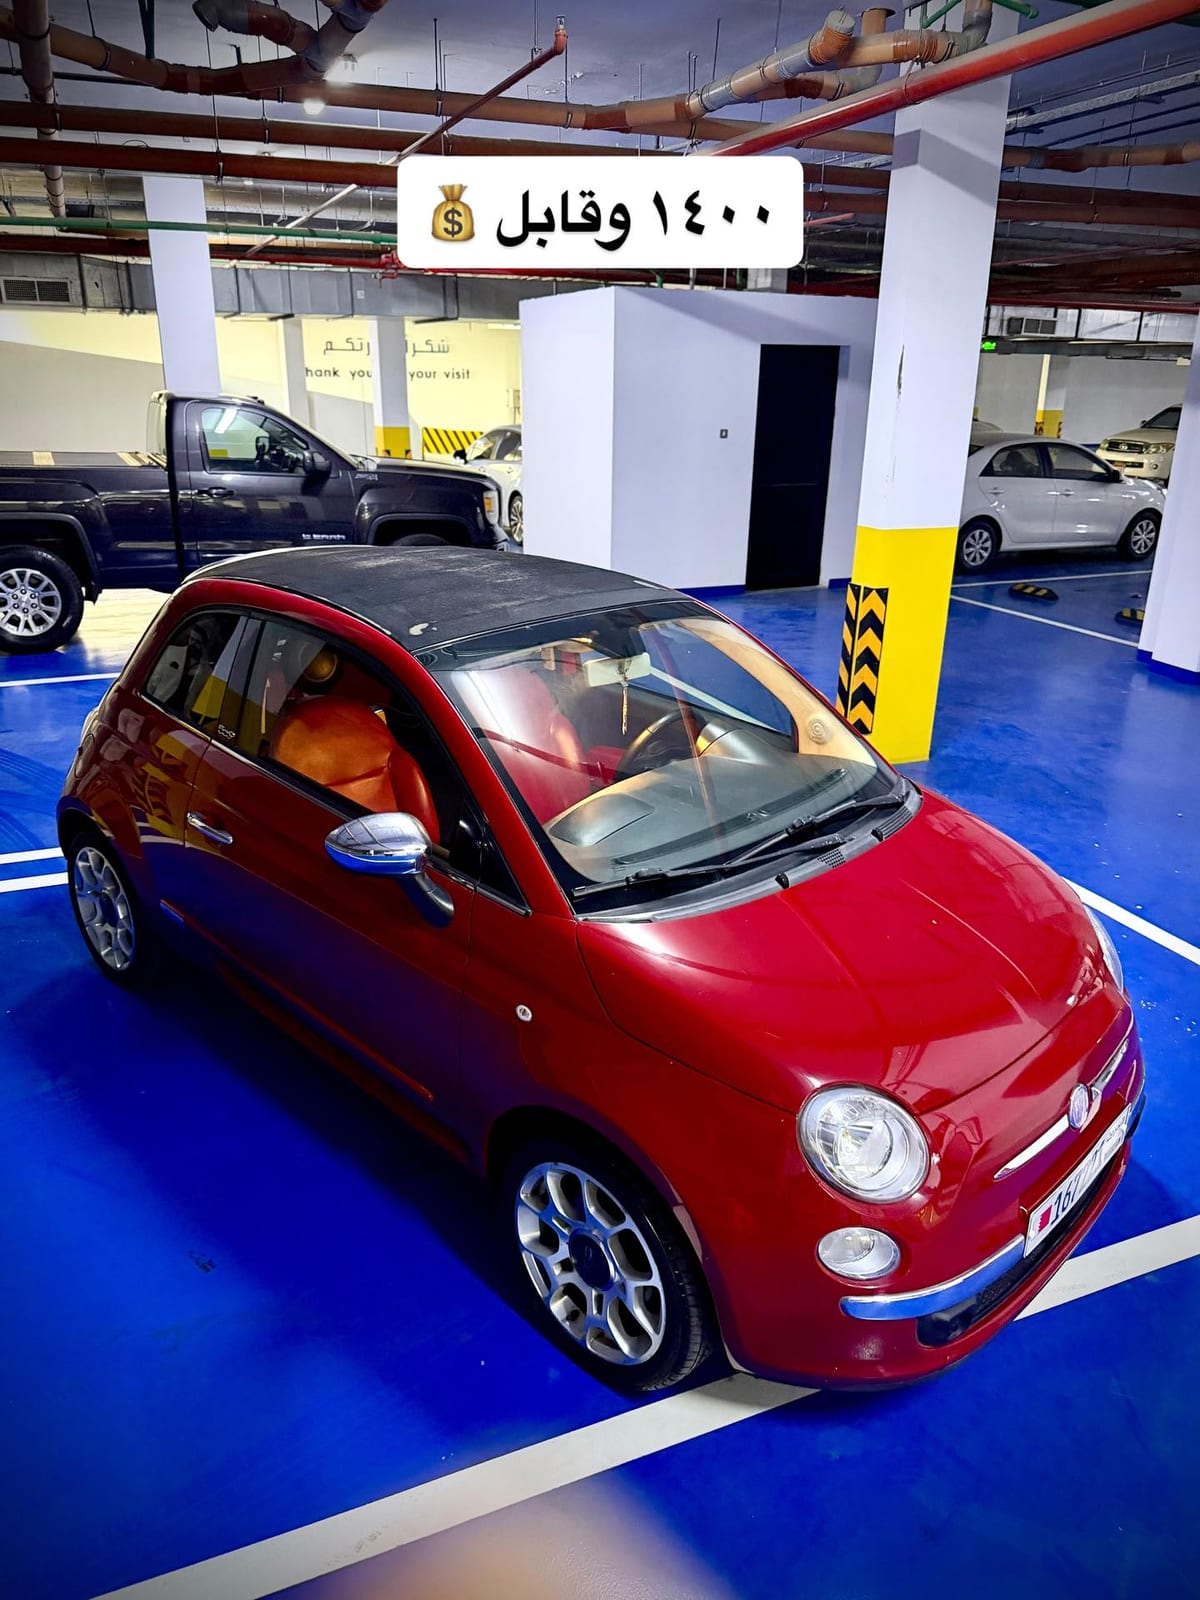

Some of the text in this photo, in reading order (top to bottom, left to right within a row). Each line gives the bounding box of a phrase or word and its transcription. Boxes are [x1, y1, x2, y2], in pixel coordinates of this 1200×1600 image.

[323, 337, 370, 356] رتكم
[304, 366, 340, 378] hank
[408, 370, 436, 381] your
[443, 367, 470, 379] visit
